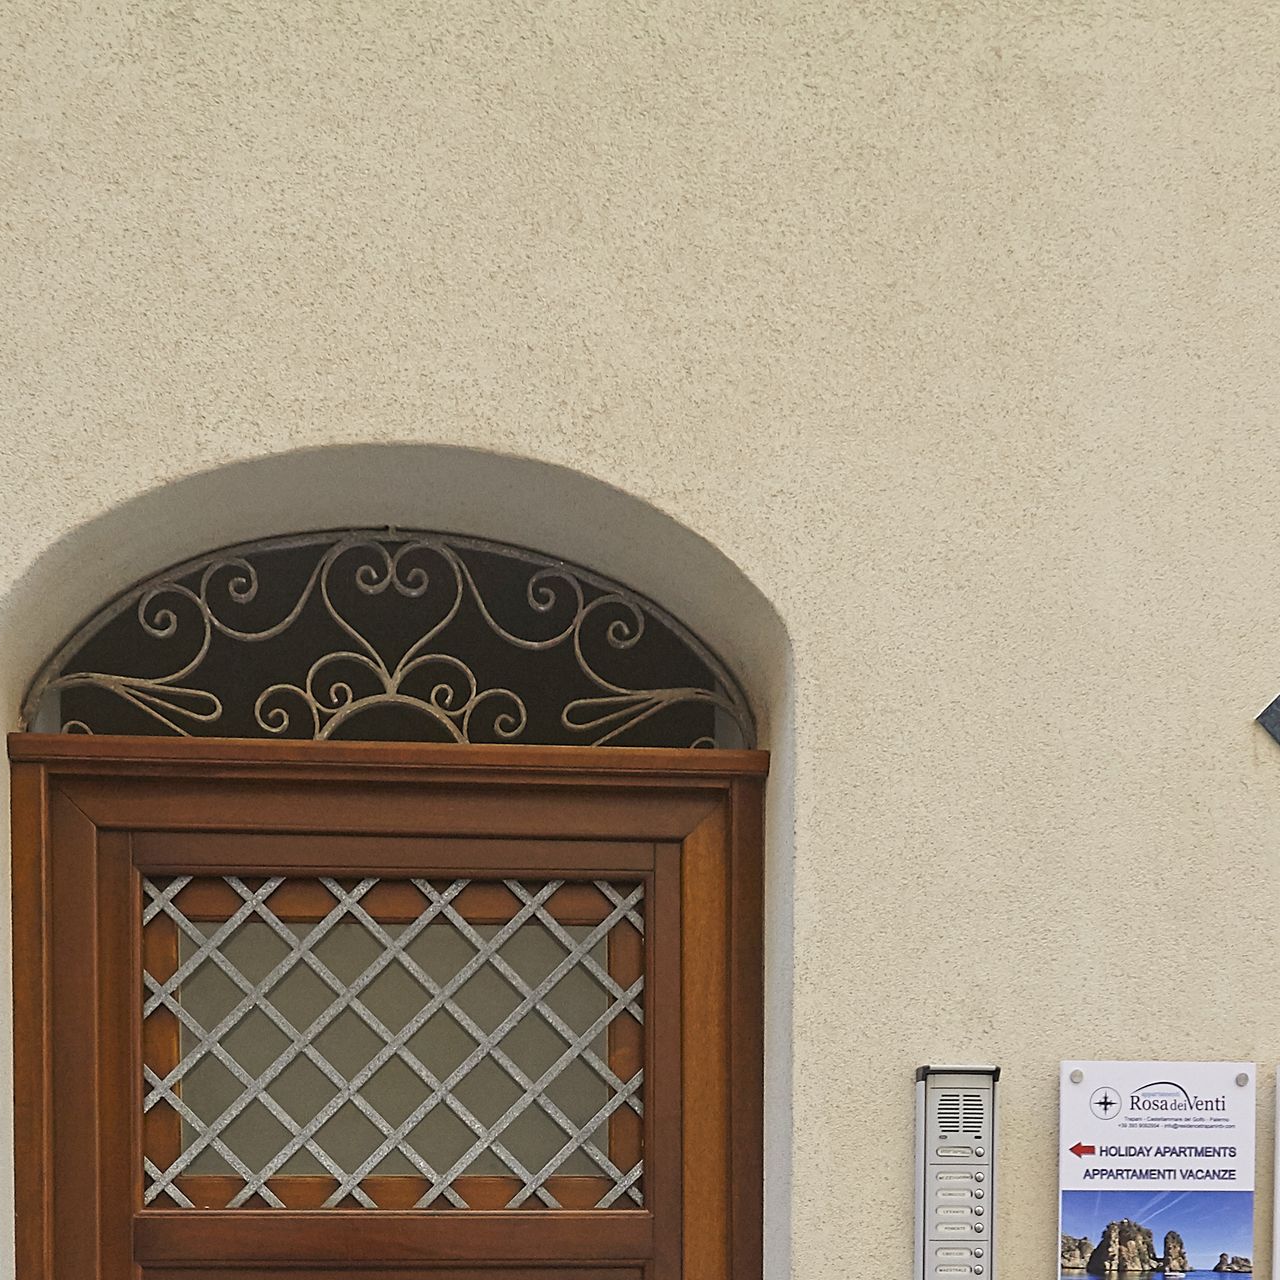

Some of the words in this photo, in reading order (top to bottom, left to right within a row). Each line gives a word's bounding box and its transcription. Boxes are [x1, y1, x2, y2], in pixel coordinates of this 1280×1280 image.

[1130, 1095, 1169, 1111] Rosa
[1170, 1099, 1187, 1111] dei
[1187, 1095, 1226, 1111] Venti
[1099, 1146, 1152, 1158] HOLIDAY
[1154, 1146, 1237, 1158] APARTMENTS
[1083, 1168, 1177, 1180] APPARTAMENTI
[1180, 1169, 1237, 1181] VACANZE
